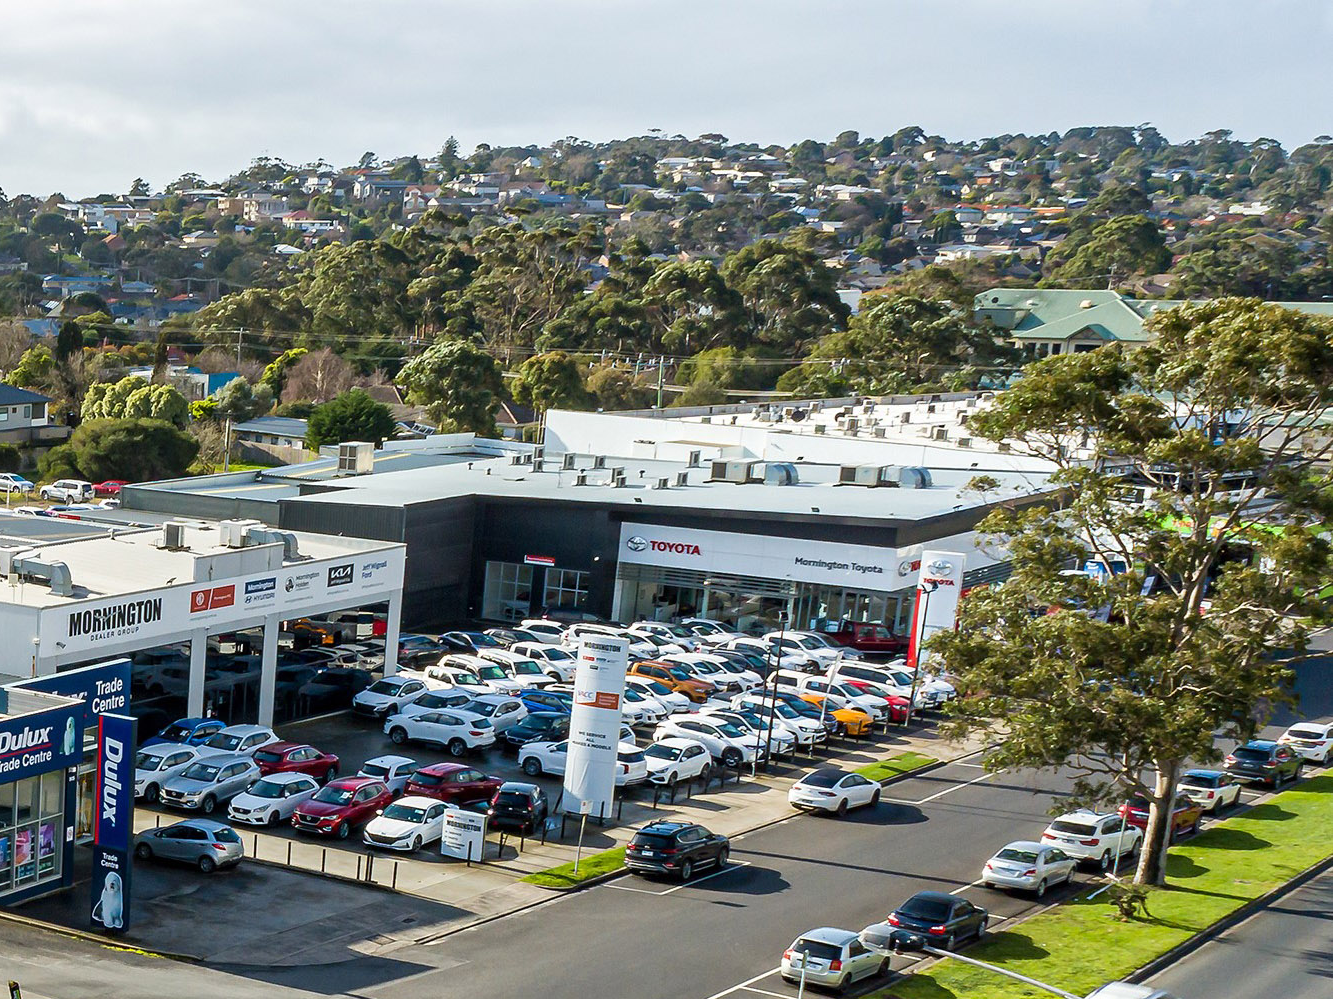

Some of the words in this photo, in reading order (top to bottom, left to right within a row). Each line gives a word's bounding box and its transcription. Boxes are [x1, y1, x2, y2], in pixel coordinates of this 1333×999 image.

[650, 540, 701, 556] TOYOTA
[795, 557, 849, 571] Mornington
[851, 562, 883, 575] Toyota
[69, 597, 163, 637] MORNINGTON
[90, 632, 115, 642] DEALER
[117, 627, 140, 637] GROUP
[95, 677, 123, 696] Trade
[92, 694, 125, 714] Centre
[22, 750, 52, 768] Centre
[102, 736, 123, 827] Dulux
[100, 859, 119, 870] Centre
[102, 852, 118, 862] Trade
